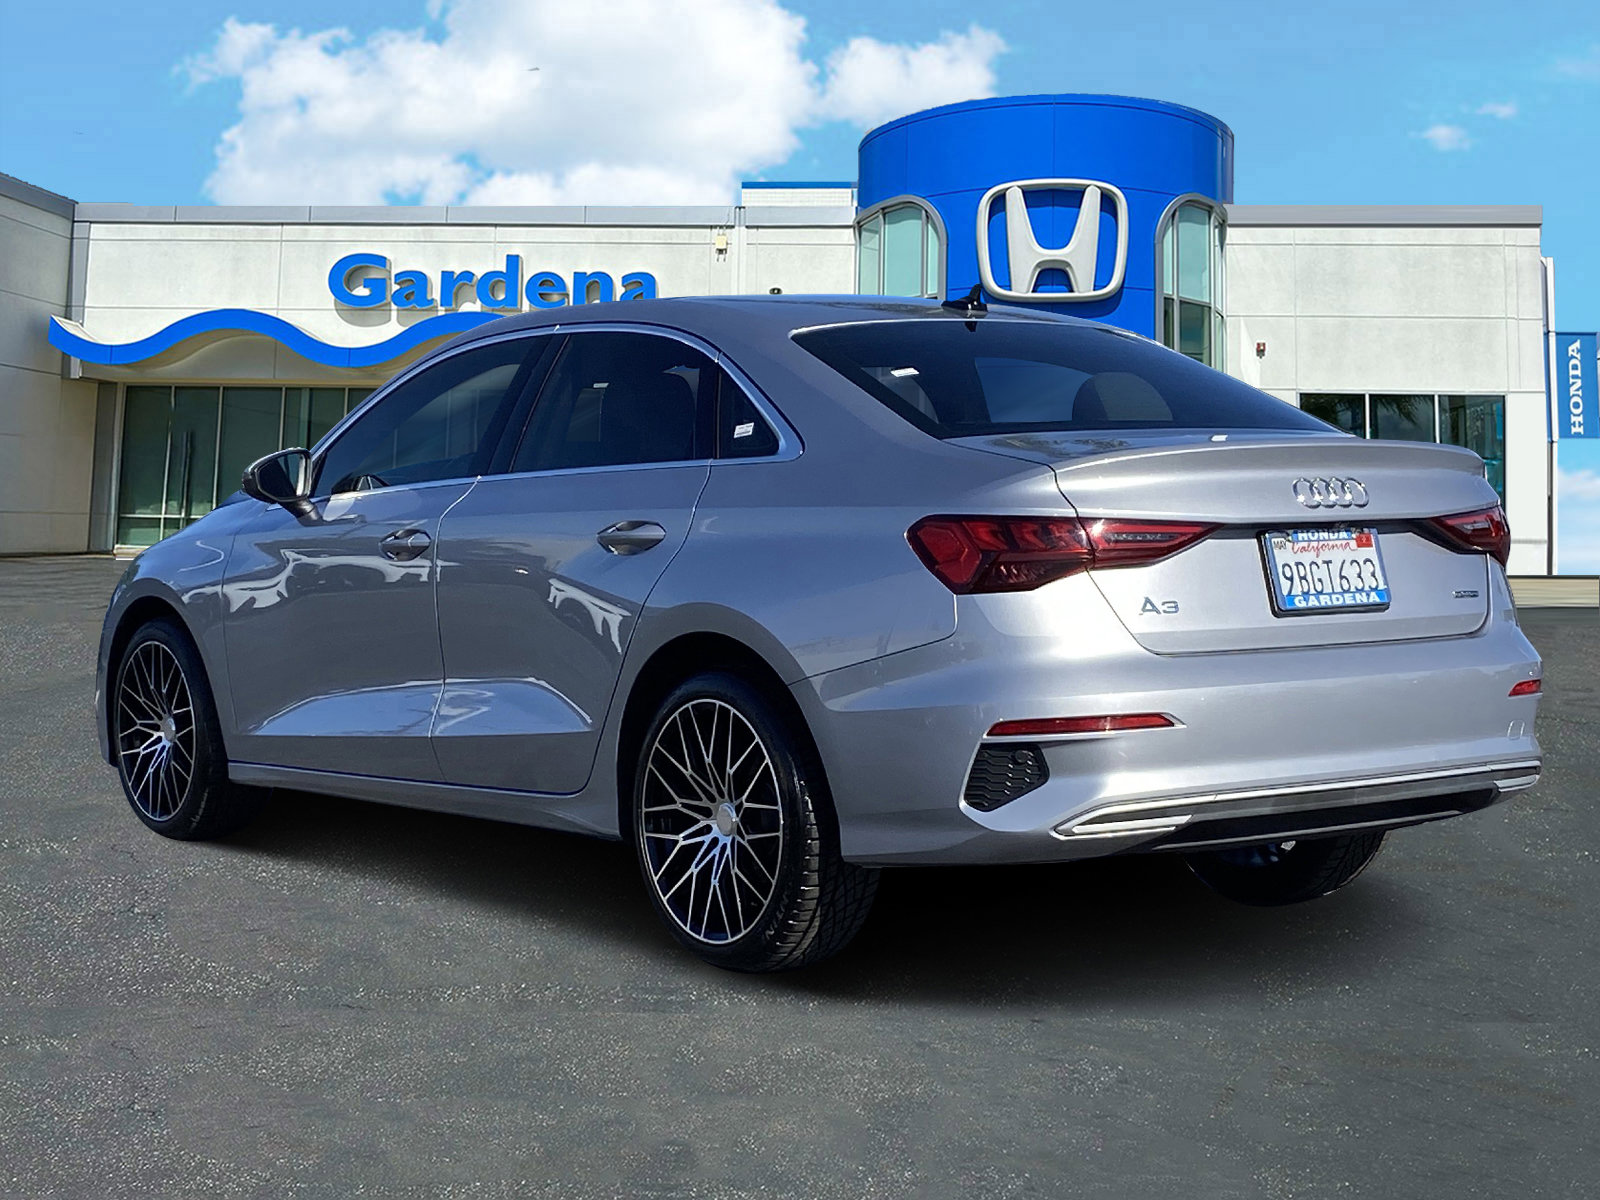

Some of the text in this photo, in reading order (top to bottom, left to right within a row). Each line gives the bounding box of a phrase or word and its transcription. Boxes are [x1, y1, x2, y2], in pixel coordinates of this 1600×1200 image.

[328, 253, 657, 309] Gardena
[1567, 339, 1584, 435] HONDA
[1297, 529, 1350, 541] HONDA
[1291, 540, 1358, 558] California
[1282, 558, 1380, 596] 9BGT633
[1139, 596, 1180, 616] A3
[1294, 591, 1381, 608] GARDENA
